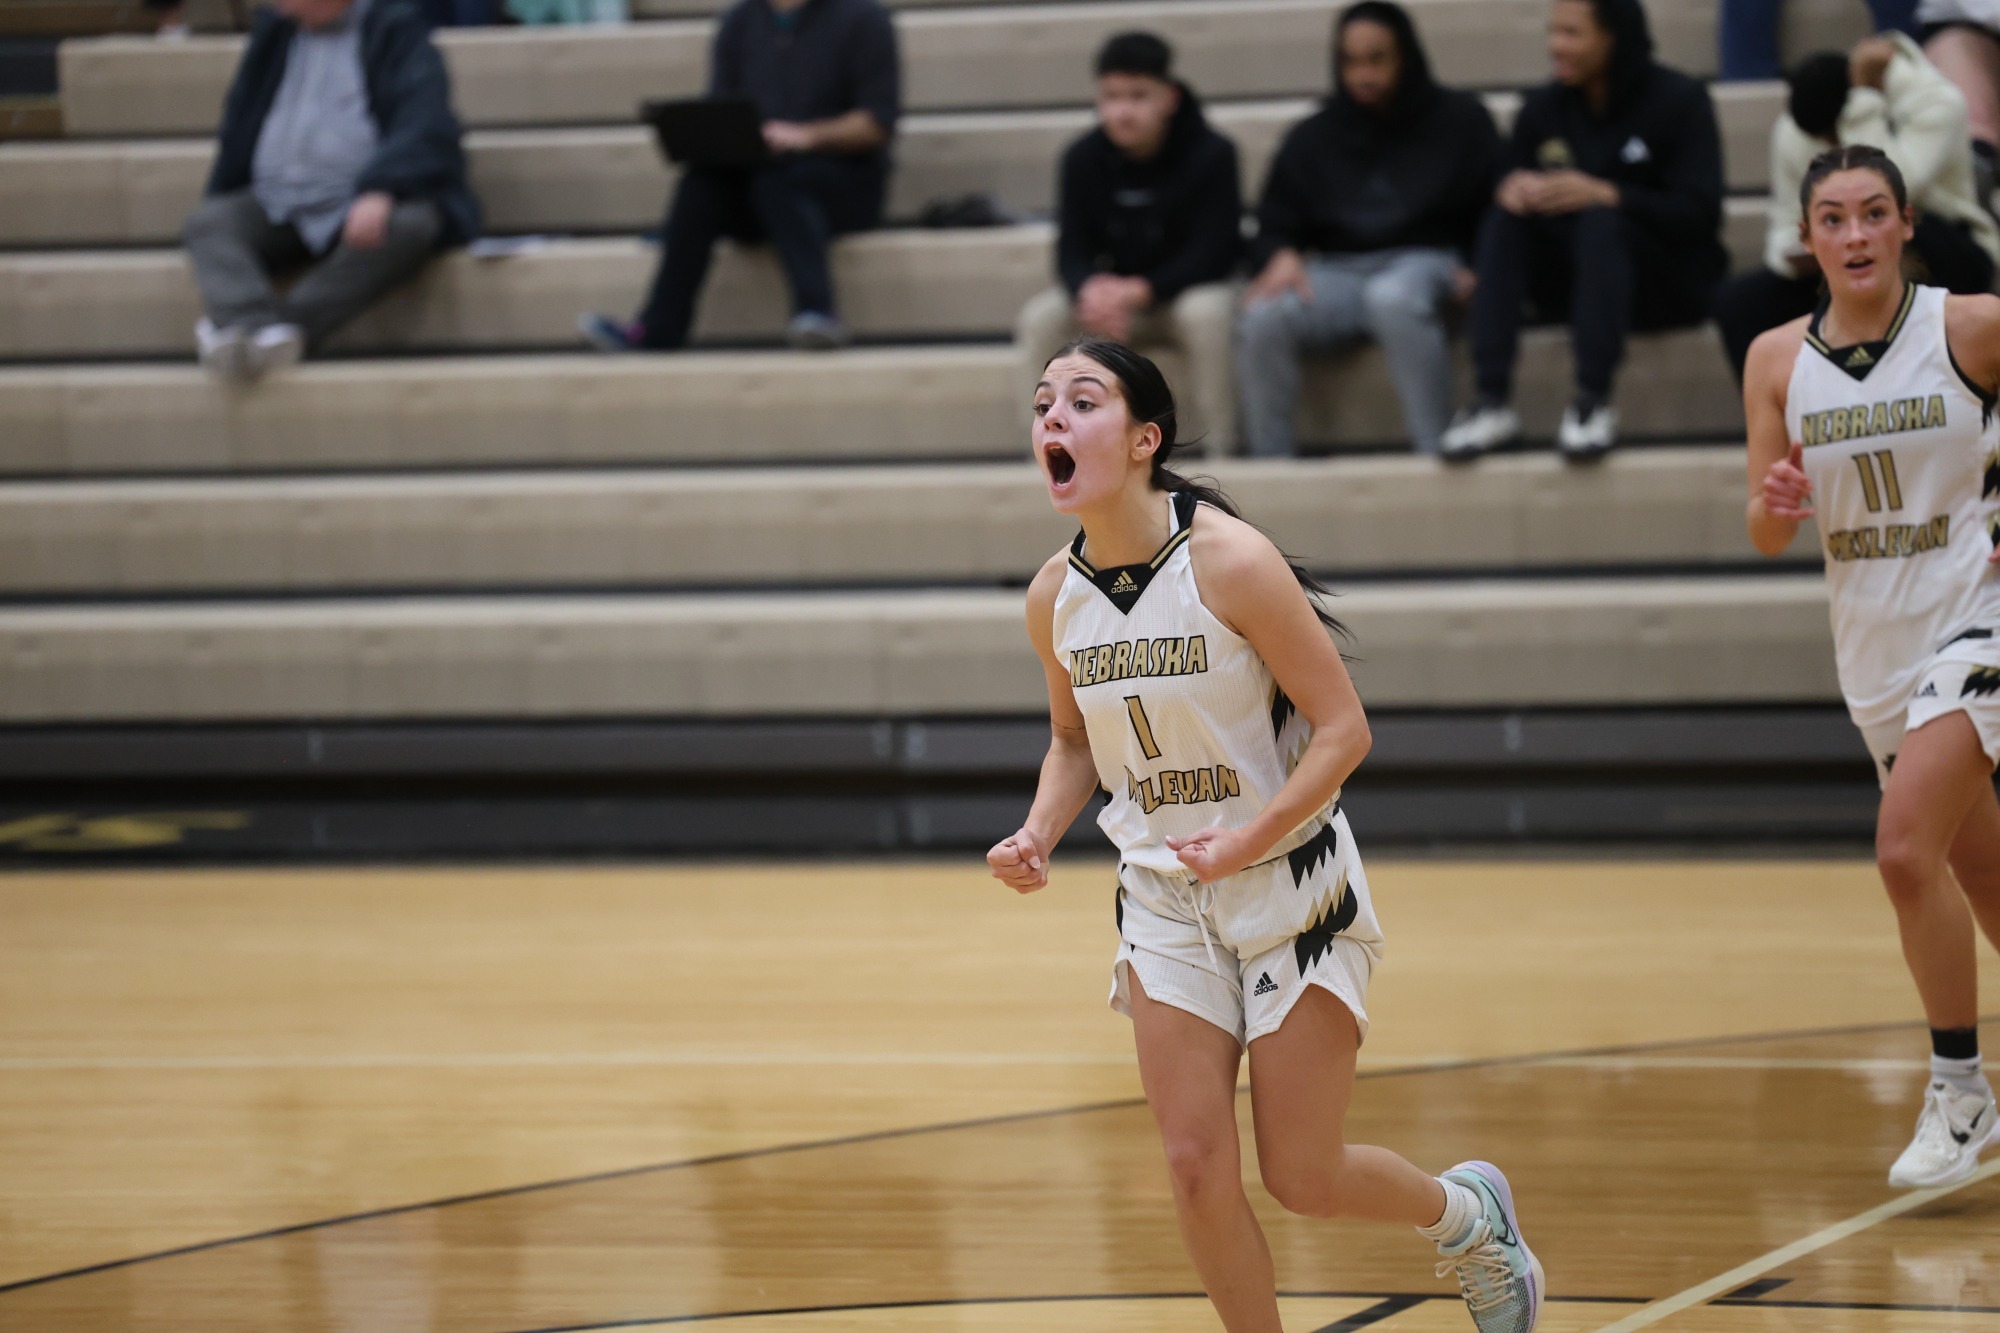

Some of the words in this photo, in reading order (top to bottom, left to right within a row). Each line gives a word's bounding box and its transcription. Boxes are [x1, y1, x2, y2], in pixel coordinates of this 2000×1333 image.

[1801, 394, 1947, 447] NEBRASKA
[1852, 449, 1903, 513] 11
[1111, 584, 1138, 594] adidas
[1070, 635, 1208, 688] NEBRASKA
[1123, 695, 1162, 760] 1
[1124, 765, 1240, 814] LEYAN
[1253, 984, 1278, 997] adidas
